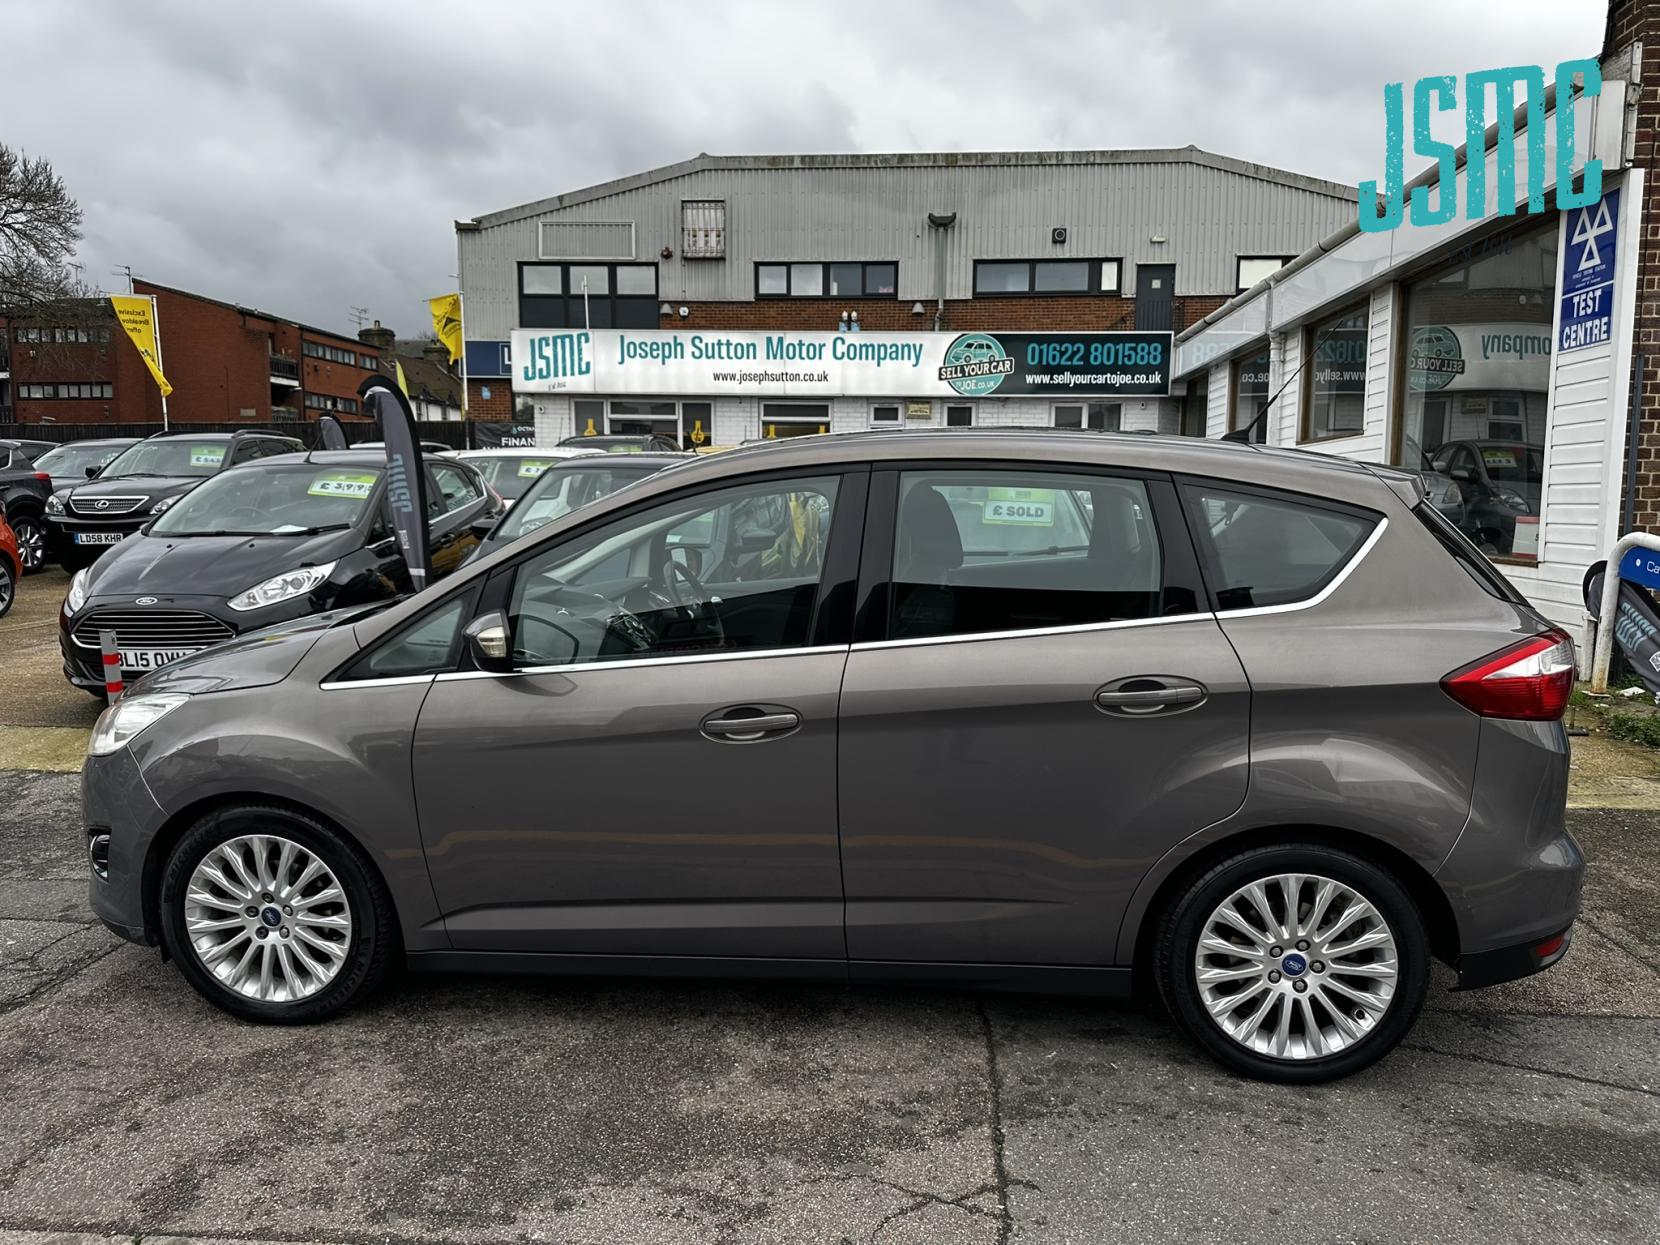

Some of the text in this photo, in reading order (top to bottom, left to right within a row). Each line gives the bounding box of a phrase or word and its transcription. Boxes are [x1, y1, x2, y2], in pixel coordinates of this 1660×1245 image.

[1572, 288, 1602, 318] TEST
[1563, 316, 1608, 349] CENTRE
[523, 332, 591, 382] JSMC
[618, 334, 924, 368] Joseph Sutton Motor Company
[1026, 342, 1162, 366] 01622 801588
[712, 369, 829, 385] www.josephsutton.co.uk
[940, 360, 1011, 379] SELL YOUR CAR
[1025, 371, 1162, 387] www.sellyourcartojoe.co.uk
[320, 482, 330, 490] £
[992, 505, 1045, 518] £ SOLD
[79, 533, 122, 544] LD58 KHR
